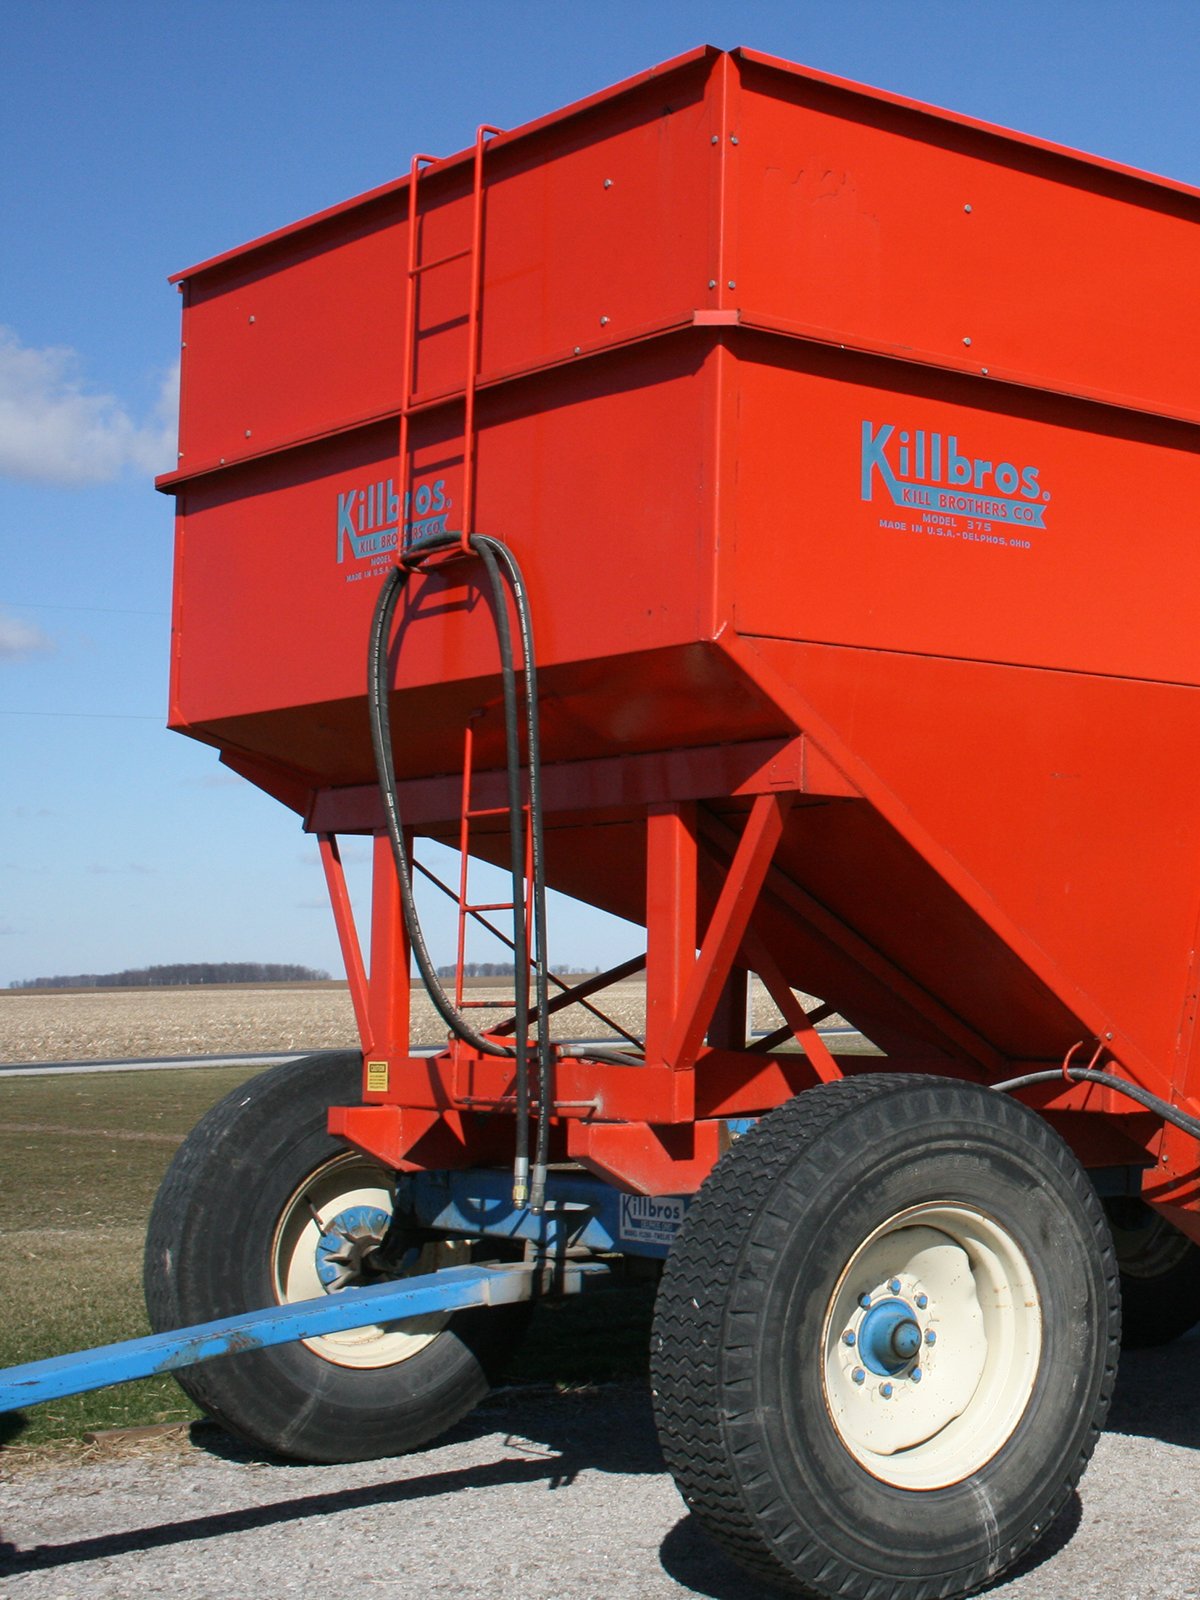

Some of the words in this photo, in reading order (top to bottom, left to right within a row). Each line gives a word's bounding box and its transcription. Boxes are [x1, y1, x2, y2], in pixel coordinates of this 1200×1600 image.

[903, 487, 931, 506] KILL
[939, 494, 1008, 518] BROTHERS
[1013, 506, 1037, 523] CO.
[879, 518, 907, 531] MADE
[911, 523, 923, 534] IN
[1010, 538, 1031, 549] OHIO
[922, 512, 957, 528] MODEL
[967, 519, 992, 532] 375
[360, 539, 377, 553] KILL
[371, 555, 392, 566] MODEL
[622, 1194, 680, 1228] Killbros
